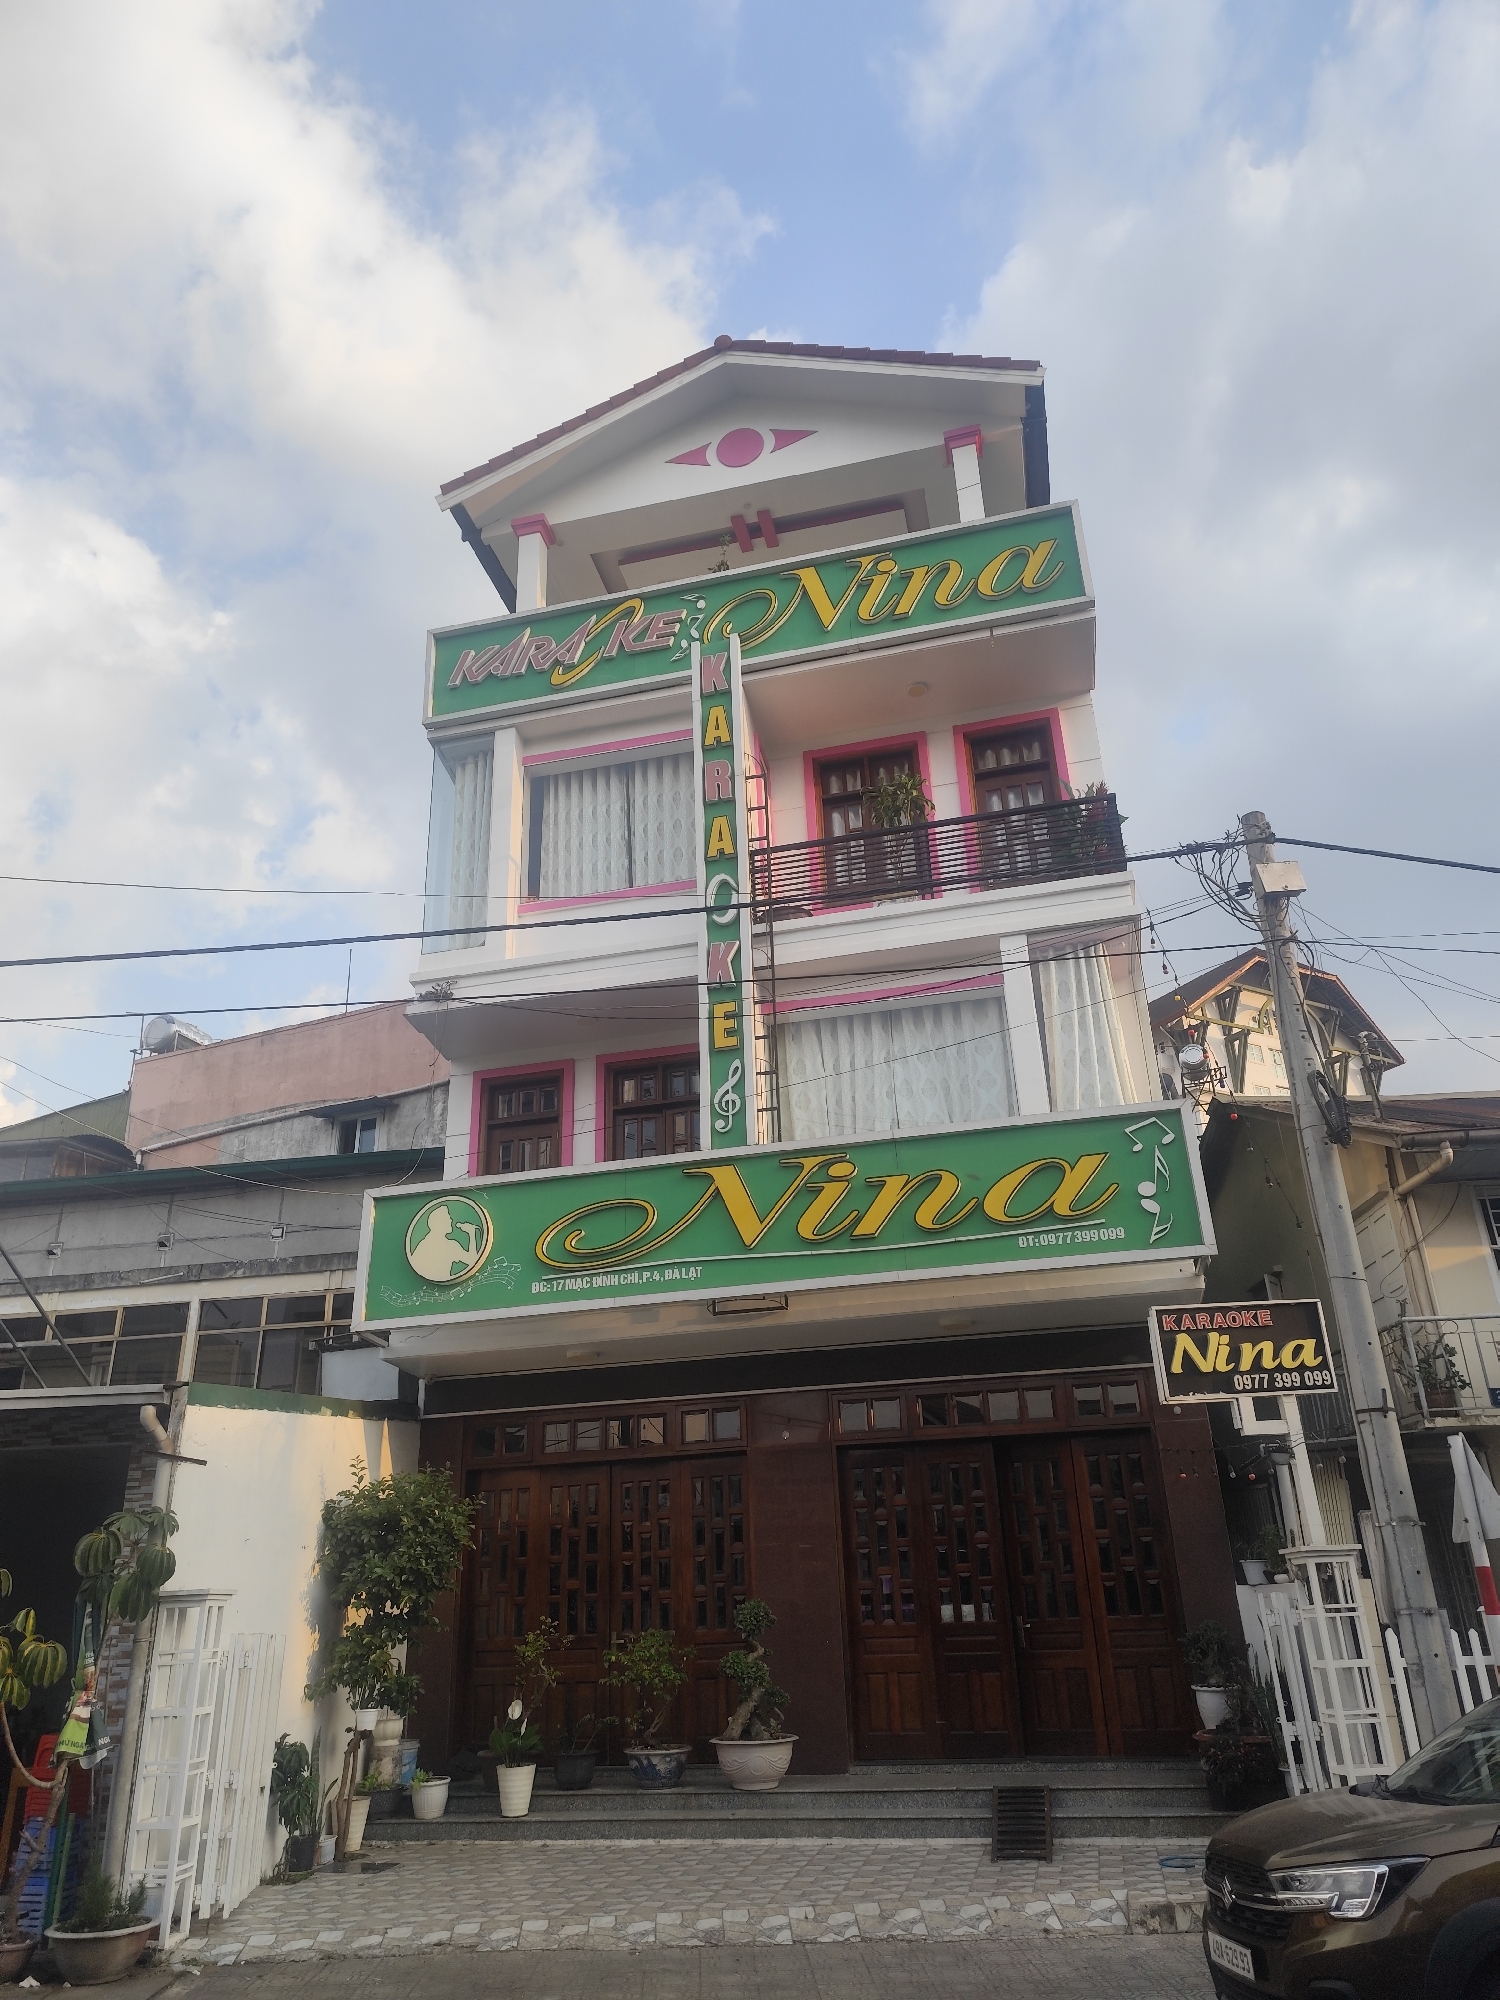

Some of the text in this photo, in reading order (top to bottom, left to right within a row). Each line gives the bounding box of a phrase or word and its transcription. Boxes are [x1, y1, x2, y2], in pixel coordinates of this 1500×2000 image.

[702, 538, 1065, 650] Nina
[535, 1151, 1120, 1272] Nina
[1074, 1229, 1099, 1243] 399
[1100, 1226, 1126, 1241] 099
[552, 1279, 565, 1292] 17
[565, 1276, 591, 1292] MẠC
[681, 1266, 703, 1281] LẠT
[1162, 1309, 1274, 1331] KARAOKE
[1170, 1331, 1323, 1374] Nina
[1233, 1370, 1331, 1391] 0977 399 099
